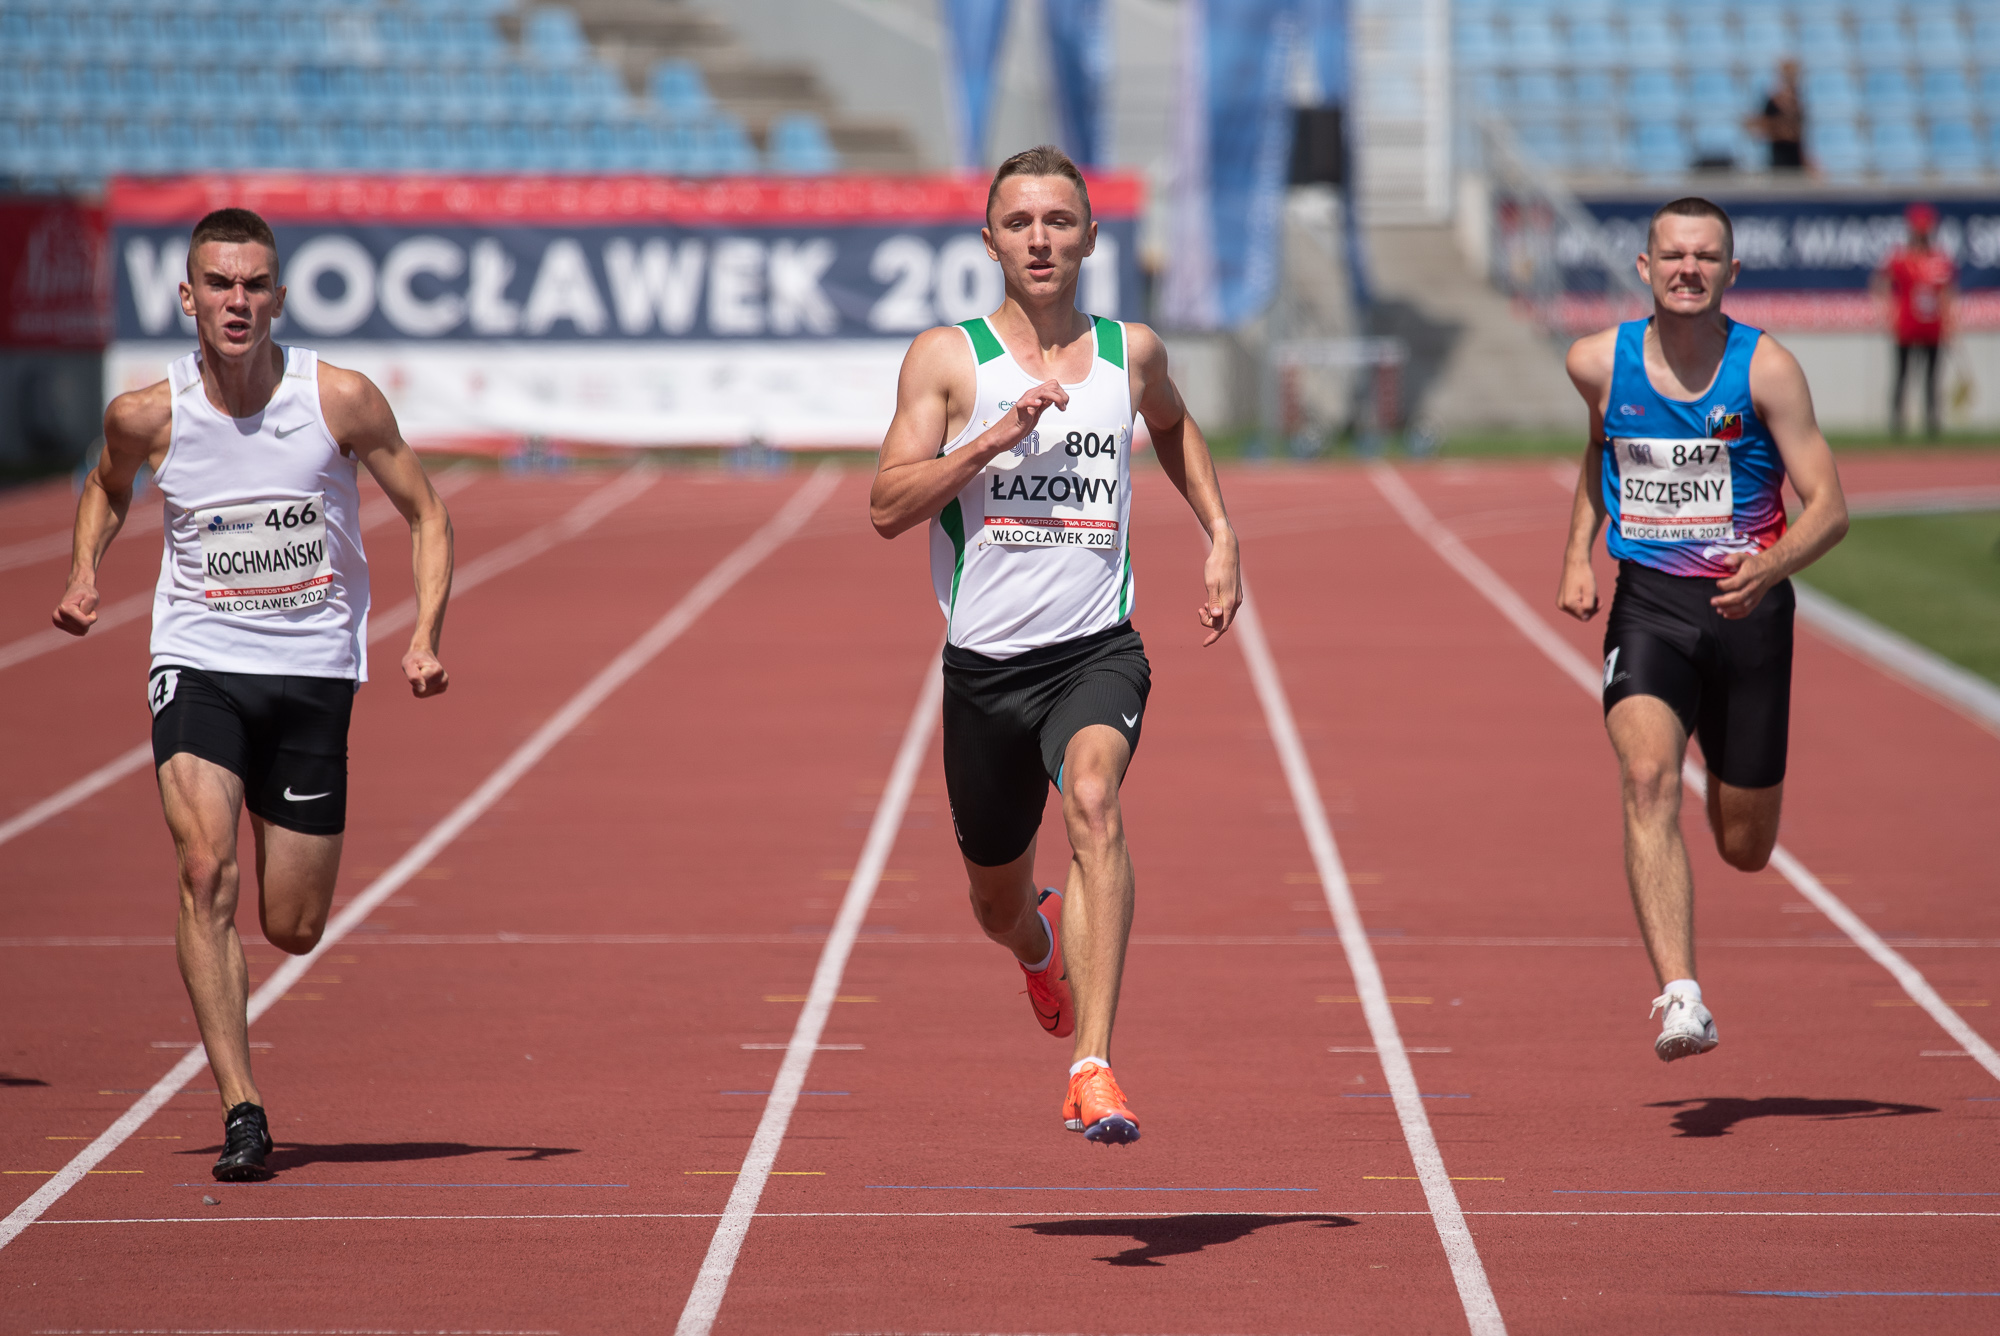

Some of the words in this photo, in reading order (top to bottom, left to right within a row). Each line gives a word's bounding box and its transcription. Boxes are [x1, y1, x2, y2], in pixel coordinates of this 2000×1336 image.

[123, 235, 839, 337] WOCŁAWEK
[867, 233, 1121, 336] 201
[1064, 431, 1117, 460] 804
[1672, 444, 1721, 467] 847
[990, 474, 1118, 505] ŁAZOWY
[1625, 478, 1726, 508] SZCZĘSNY
[264, 502, 317, 532] 466
[1004, 518, 1024, 526] PZLA
[1025, 518, 1080, 527] MISTRZOSTWA
[1080, 520, 1107, 528] POLSKI
[992, 529, 1084, 545] WŁOCŁAWEK
[1087, 533, 1117, 546] 2021
[1624, 526, 1695, 540] WŁOCŁAWEK
[1699, 526, 1727, 540] 2021
[207, 539, 324, 577] KOCHMAŃSKI
[214, 596, 299, 613] WŁOCŁAWEK
[301, 588, 329, 605] 2021
[153, 673, 169, 707] 4
